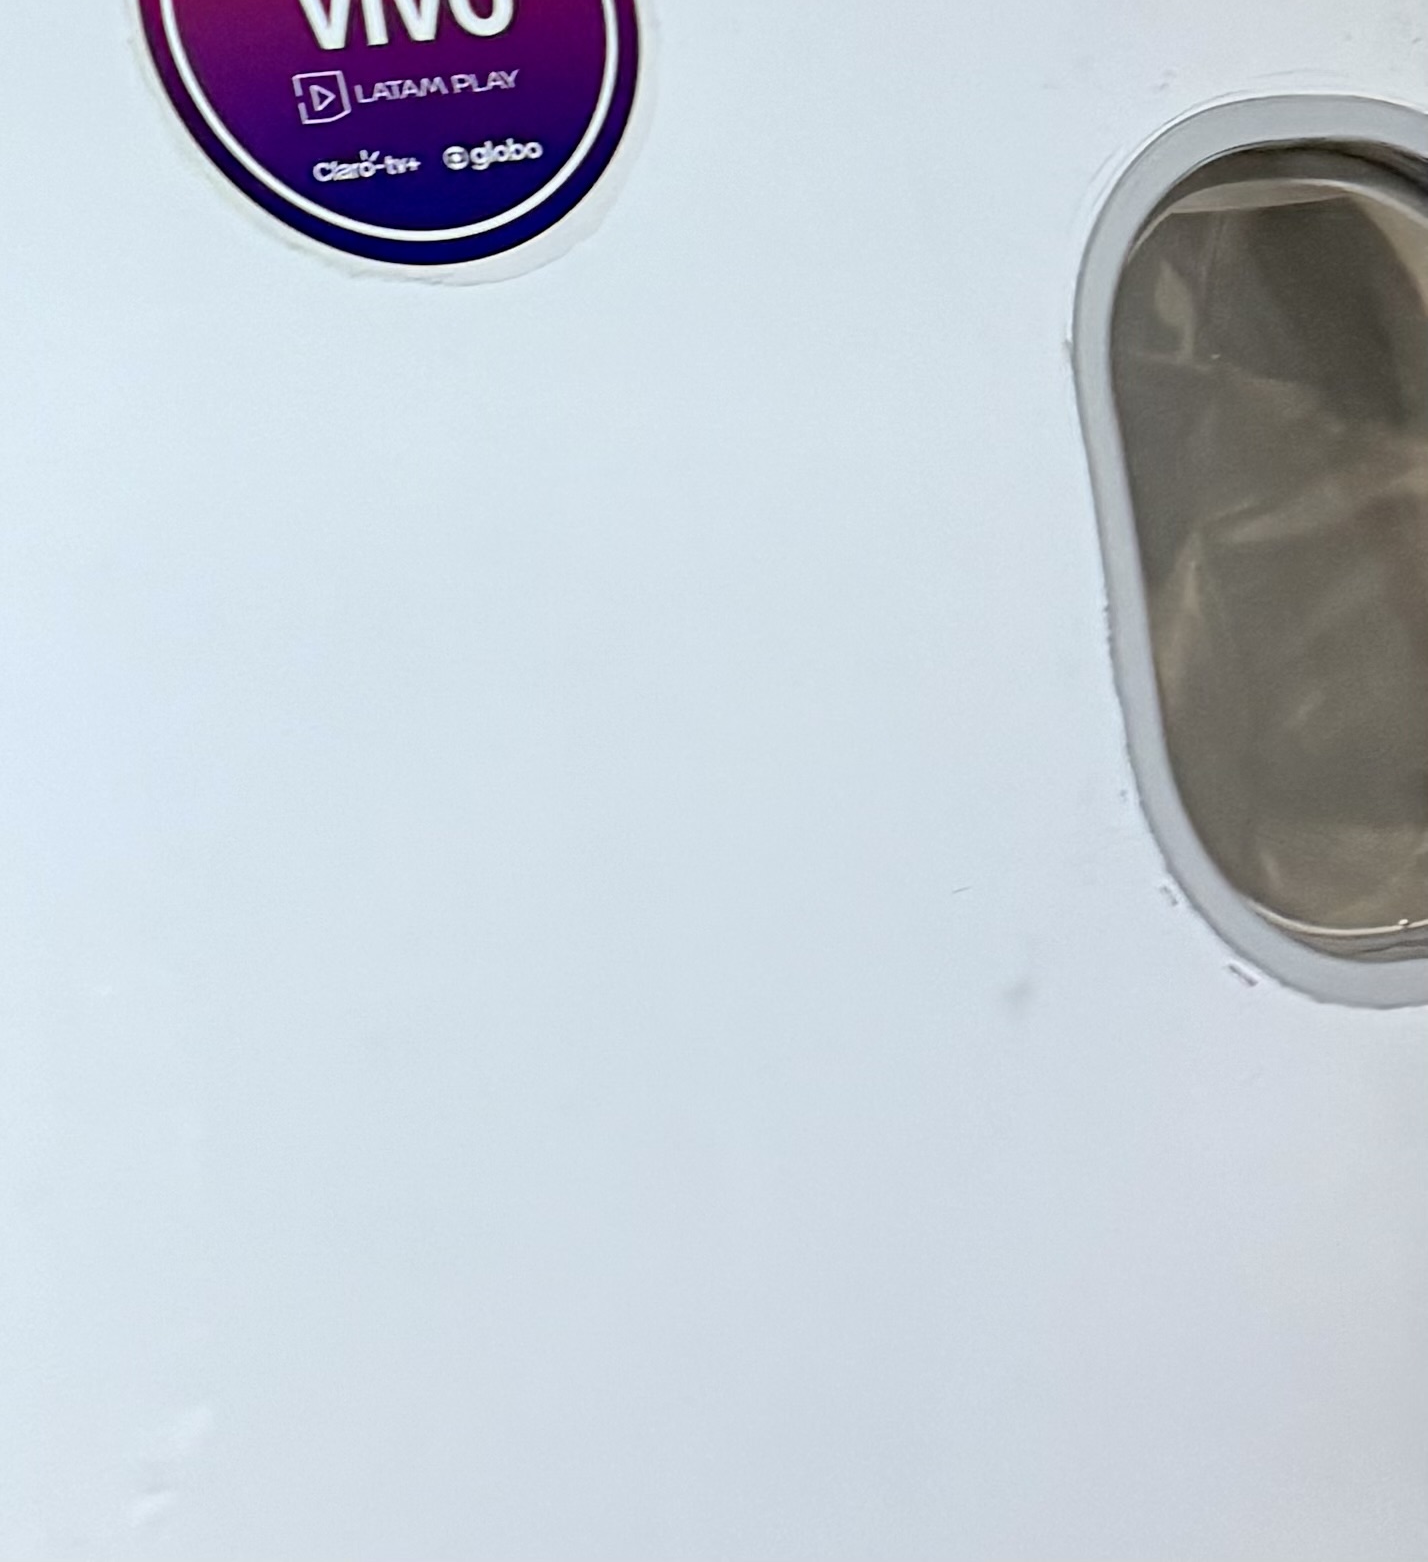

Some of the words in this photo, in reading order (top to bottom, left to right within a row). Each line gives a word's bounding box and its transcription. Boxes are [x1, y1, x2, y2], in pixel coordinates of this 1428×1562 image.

[354, 76, 449, 104] LATAM
[450, 69, 520, 94] PLAY
[470, 138, 543, 171] globo
